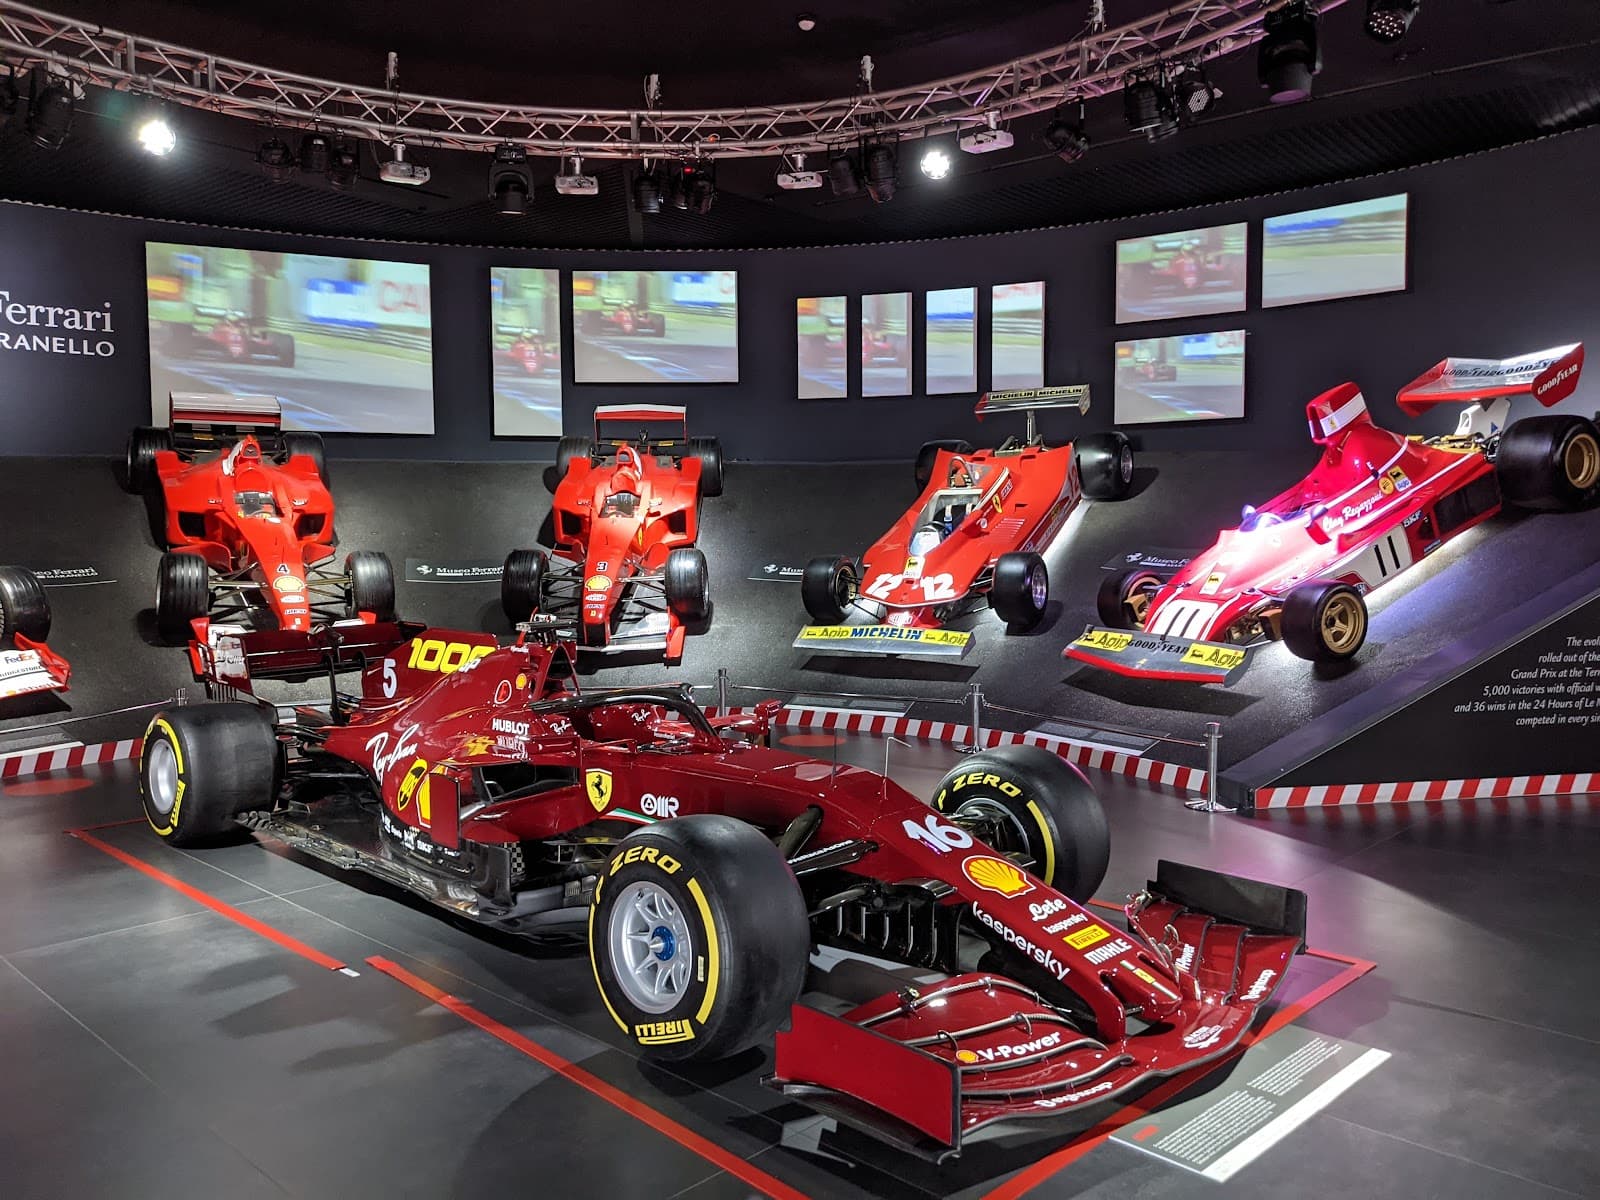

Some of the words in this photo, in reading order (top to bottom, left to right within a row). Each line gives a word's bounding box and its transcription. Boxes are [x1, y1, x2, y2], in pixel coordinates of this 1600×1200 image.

[992, 391, 1033, 400] MICHELIN
[1038, 388, 1082, 396] MICHELIN
[1341, 490, 1384, 519] Regazzoni
[1403, 510, 1422, 528] SKF
[1373, 535, 1401, 578] 11
[52, 566, 96, 576] Ferrari
[277, 563, 290, 574] 4
[596, 561, 608, 572] 3
[919, 572, 957, 601] 12
[818, 627, 850, 639] Agip
[850, 626, 924, 641] MICHELIN
[1095, 633, 1128, 650] Agip
[1566, 636, 1582, 647] The
[4, 653, 33, 664] FedEx
[1538, 651, 1563, 663] rolled
[1563, 653, 1577, 662] out
[1578, 651, 1590, 664] of
[382, 658, 398, 699] 5
[1511, 668, 1538, 680] Grand
[1540, 667, 1557, 679] Prix
[1558, 669, 1568, 678] at
[1569, 667, 1583, 678] the
[1482, 685, 1511, 698] 5,000
[1512, 683, 1545, 695] victories
[1546, 682, 1565, 694] with
[1566, 682, 1595, 696] official
[1454, 701, 1472, 713] and
[1473, 701, 1486, 712] 36
[1487, 701, 1506, 711] wins
[1508, 701, 1516, 711] in
[1518, 700, 1531, 710] the
[1532, 699, 1546, 710] 24
[1547, 699, 1573, 709] Hours
[1574, 697, 1585, 710] of
[1585, 698, 1595, 708] Le
[492, 717, 530, 736] HUBLOT
[1515, 713, 1557, 728] competed
[1557, 713, 1566, 724] in
[1567, 715, 1589, 727] every
[952, 772, 1022, 798] ZERO
[902, 814, 974, 853] 16
[609, 845, 682, 876] ZERO
[1042, 912, 1089, 935] kaspersky
[972, 900, 1071, 981] kaspersky
[1070, 928, 1104, 947] PIRELLI
[1083, 937, 1133, 965] MAHLE
[635, 1019, 696, 1045] PIRELLI
[977, 1031, 1061, 1062] V-Power
